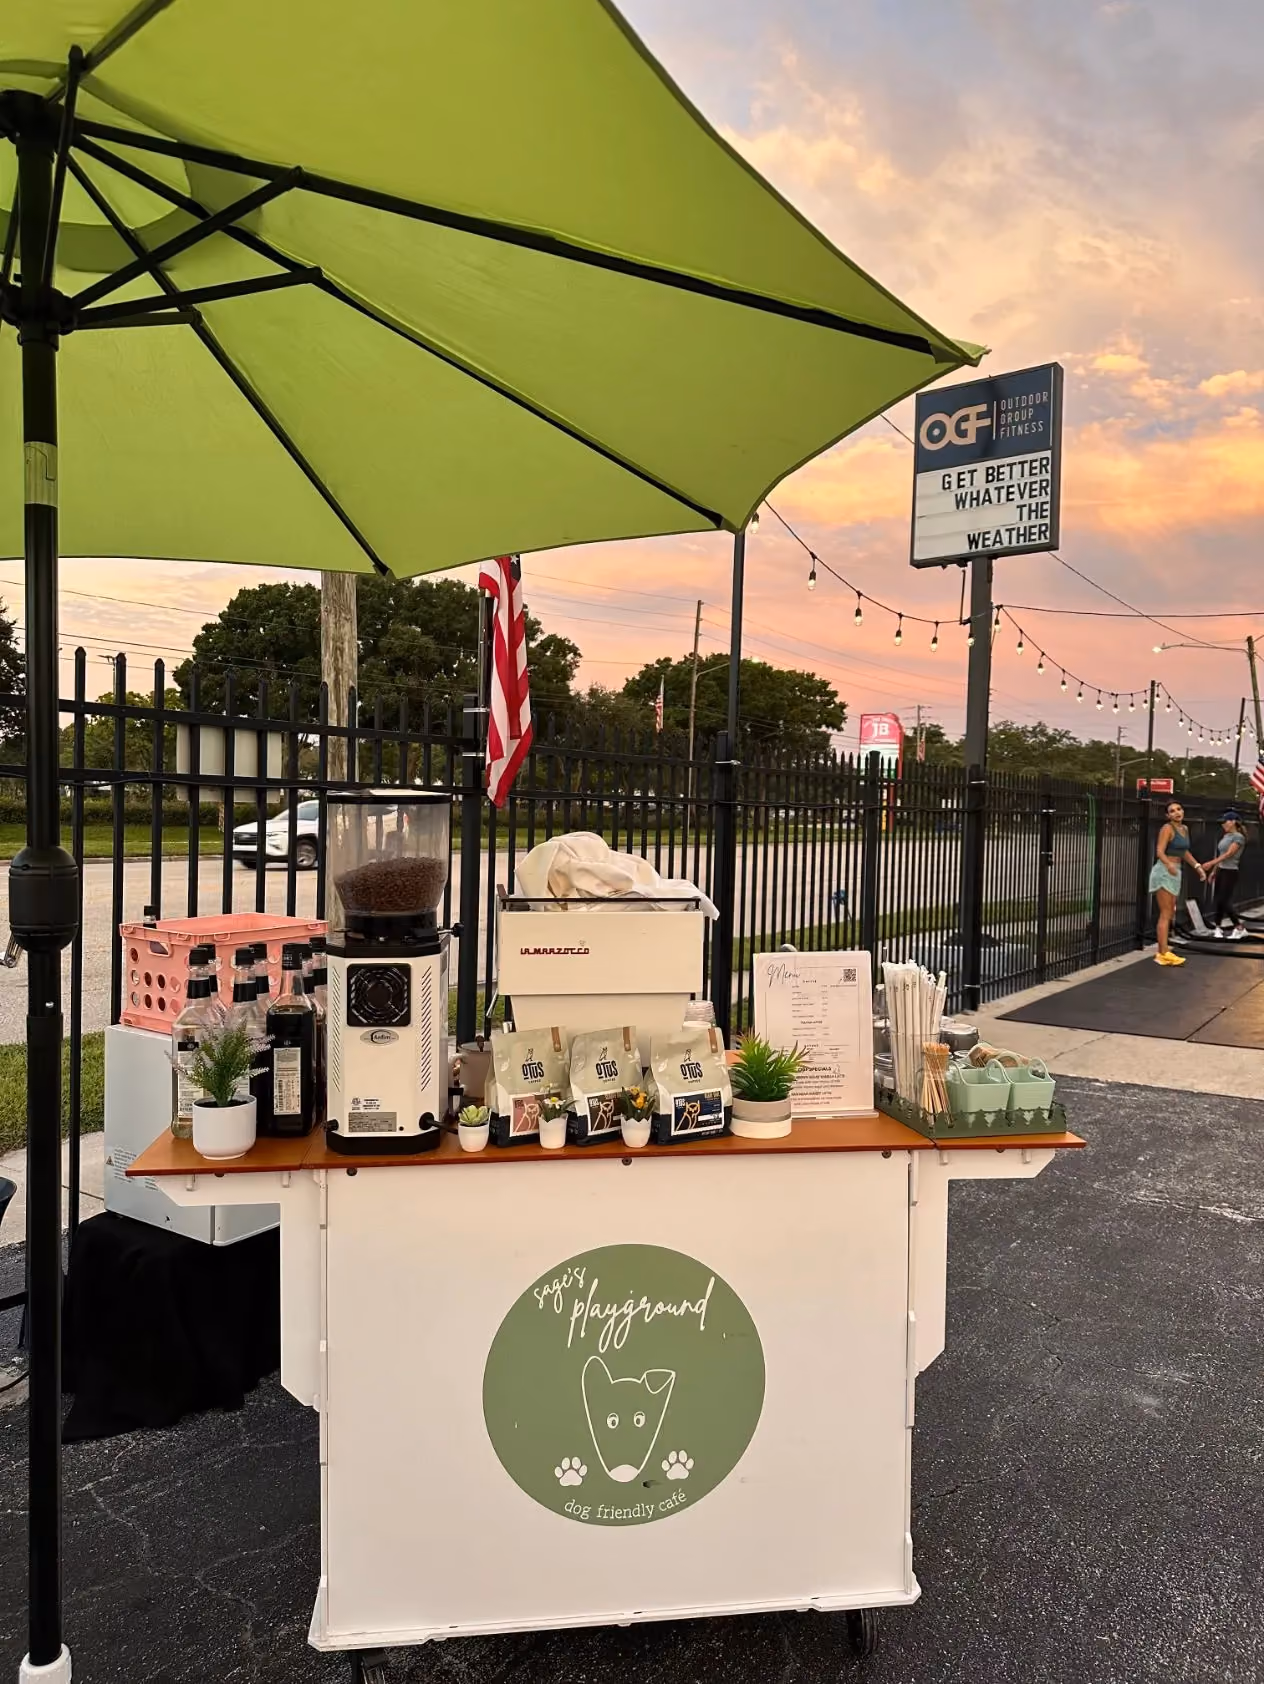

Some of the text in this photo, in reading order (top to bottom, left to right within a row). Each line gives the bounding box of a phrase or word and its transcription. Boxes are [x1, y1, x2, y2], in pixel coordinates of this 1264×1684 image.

[1000, 391, 1048, 411] OUTDOOR
[1000, 408, 1034, 425] GROUP
[1000, 420, 1044, 440] FITNESS
[942, 456, 1050, 491] GET BETTER
[955, 478, 1050, 510] WHATEVER
[1016, 501, 1049, 522] THE
[967, 522, 1049, 551] WEATHER
[767, 963, 801, 989] Menu
[521, 1061, 545, 1080] OTUS
[595, 1060, 618, 1080] OTUS
[680, 1062, 704, 1080] OTUS
[533, 1266, 587, 1314] sage's
[566, 1276, 716, 1354] playground
[563, 1488, 688, 1521] dog friendly café
